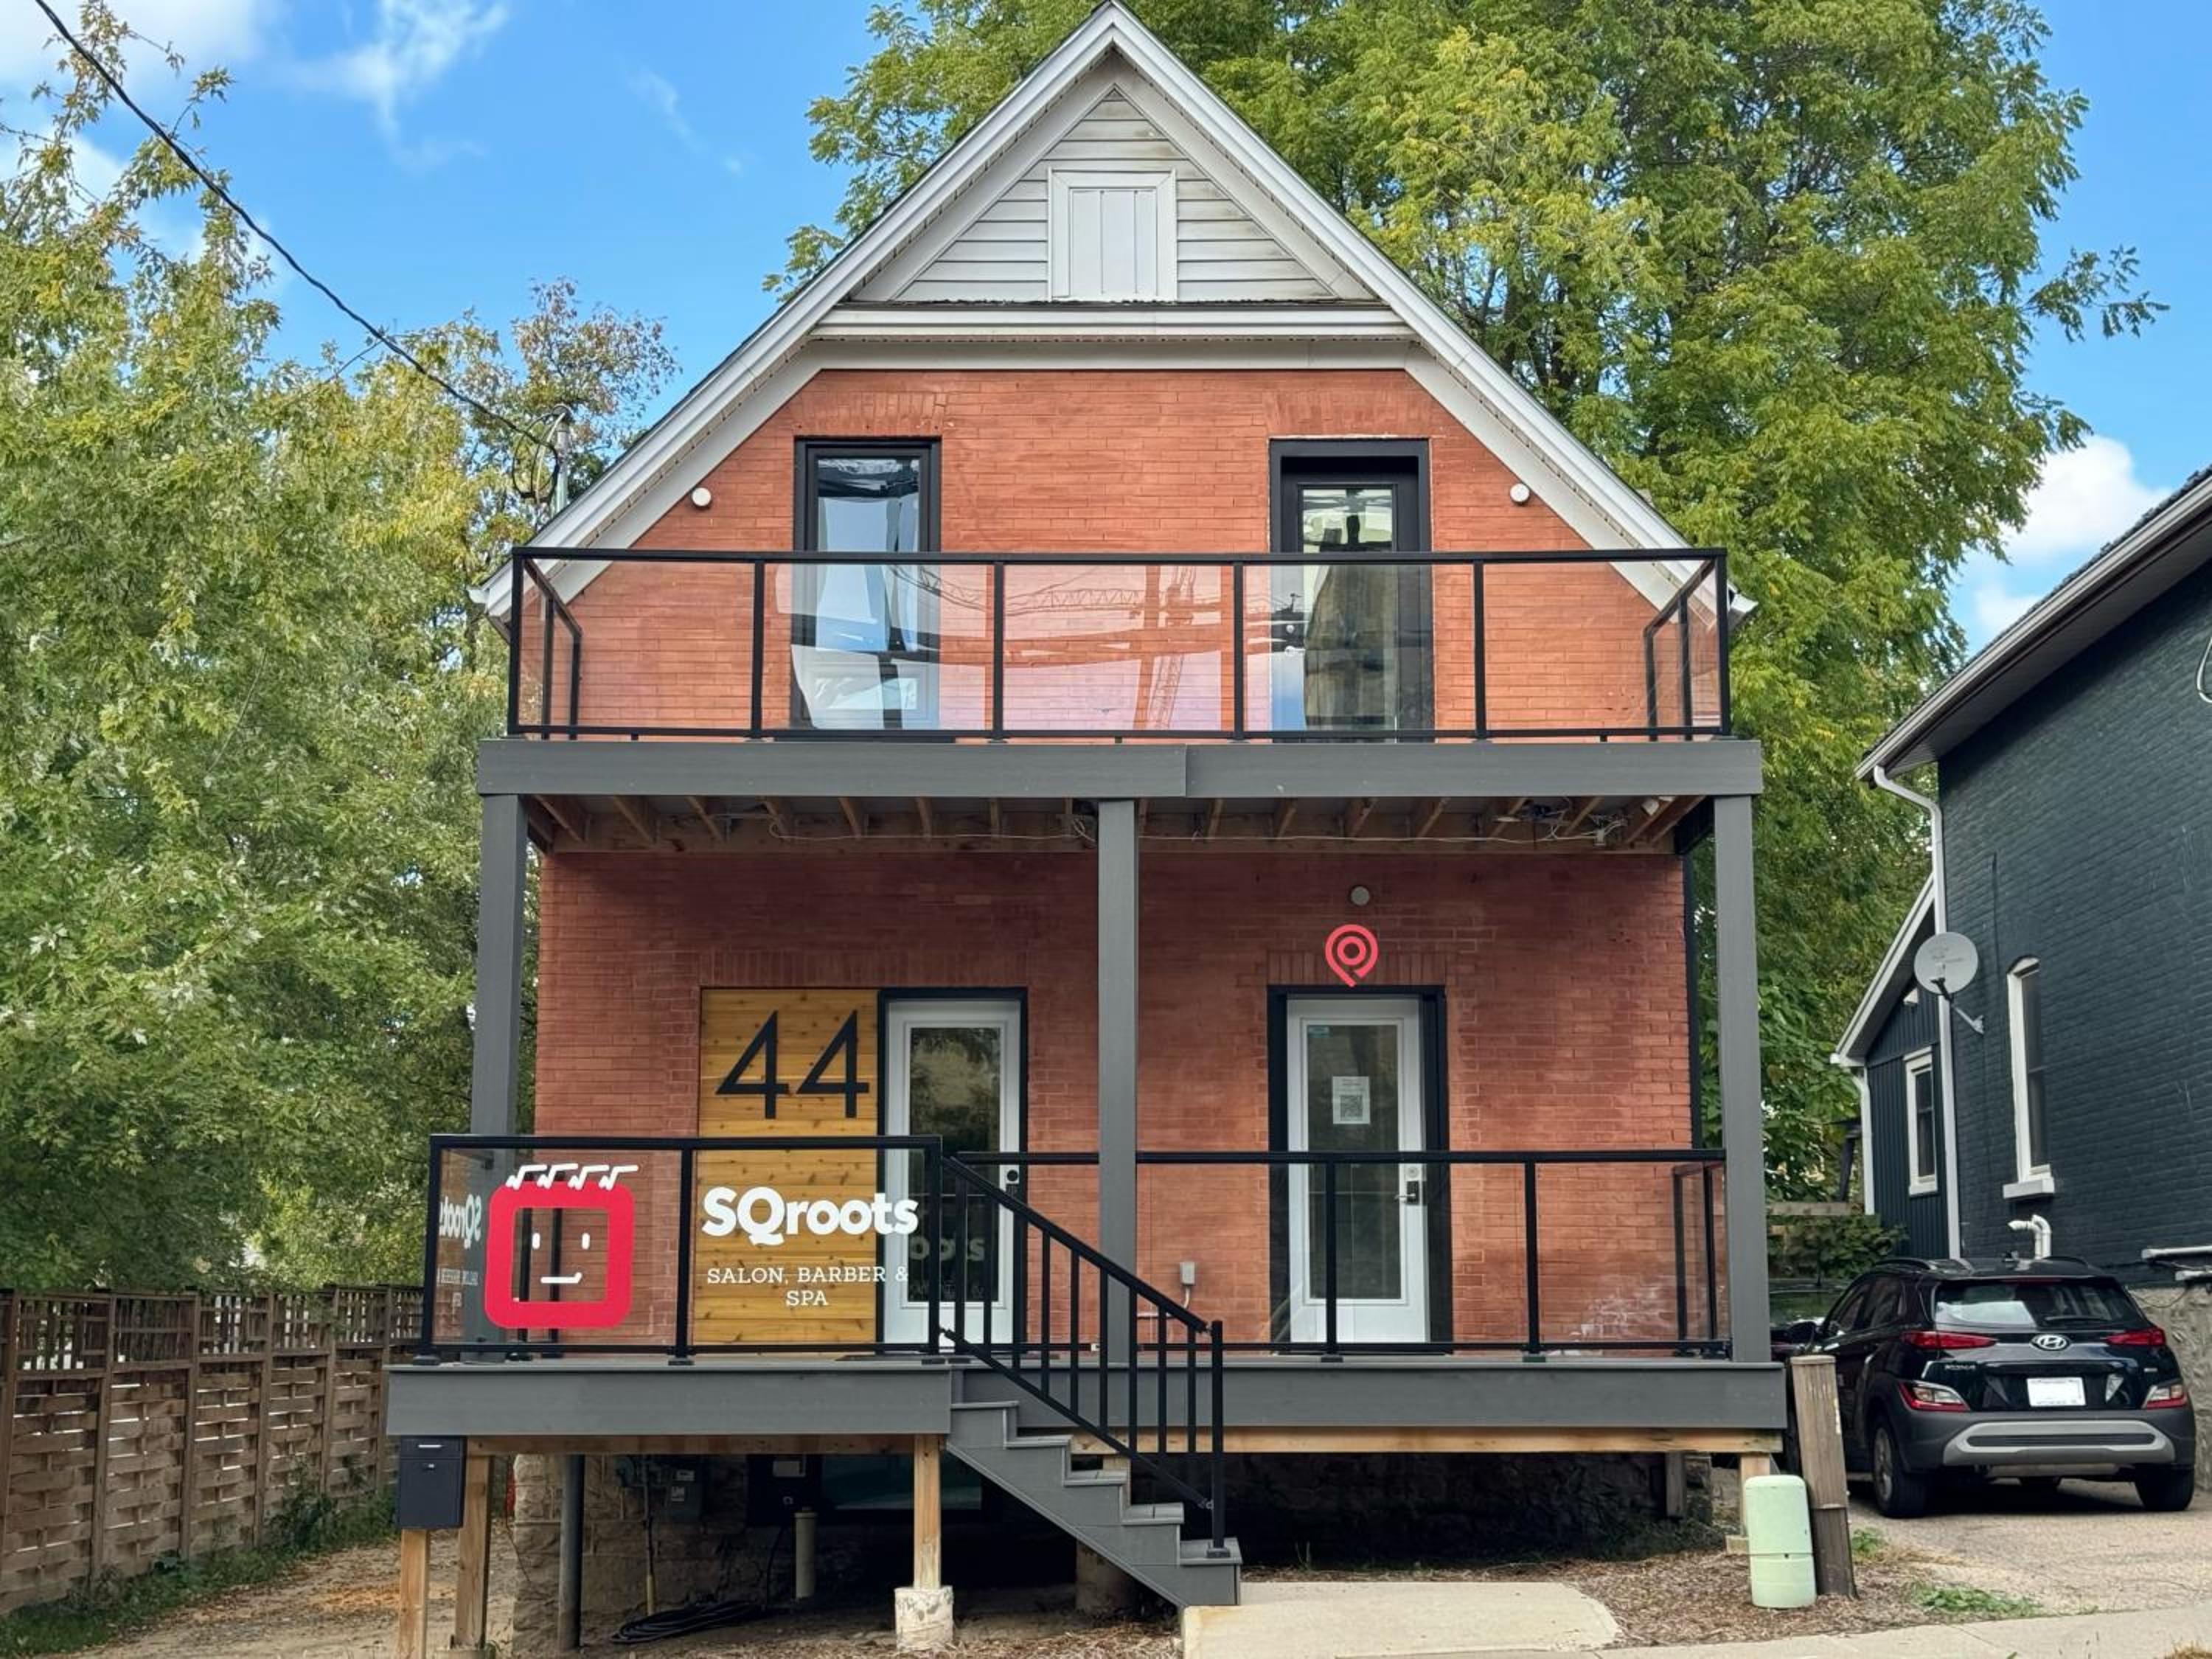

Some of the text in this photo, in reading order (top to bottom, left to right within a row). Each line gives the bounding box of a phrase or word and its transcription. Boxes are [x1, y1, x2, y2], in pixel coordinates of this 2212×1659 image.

[716, 1010, 870, 1119] 44
[702, 1186, 919, 1246] SQroots
[707, 1265, 909, 1285] SALON, BARBER &
[785, 1290, 829, 1306] SPA
